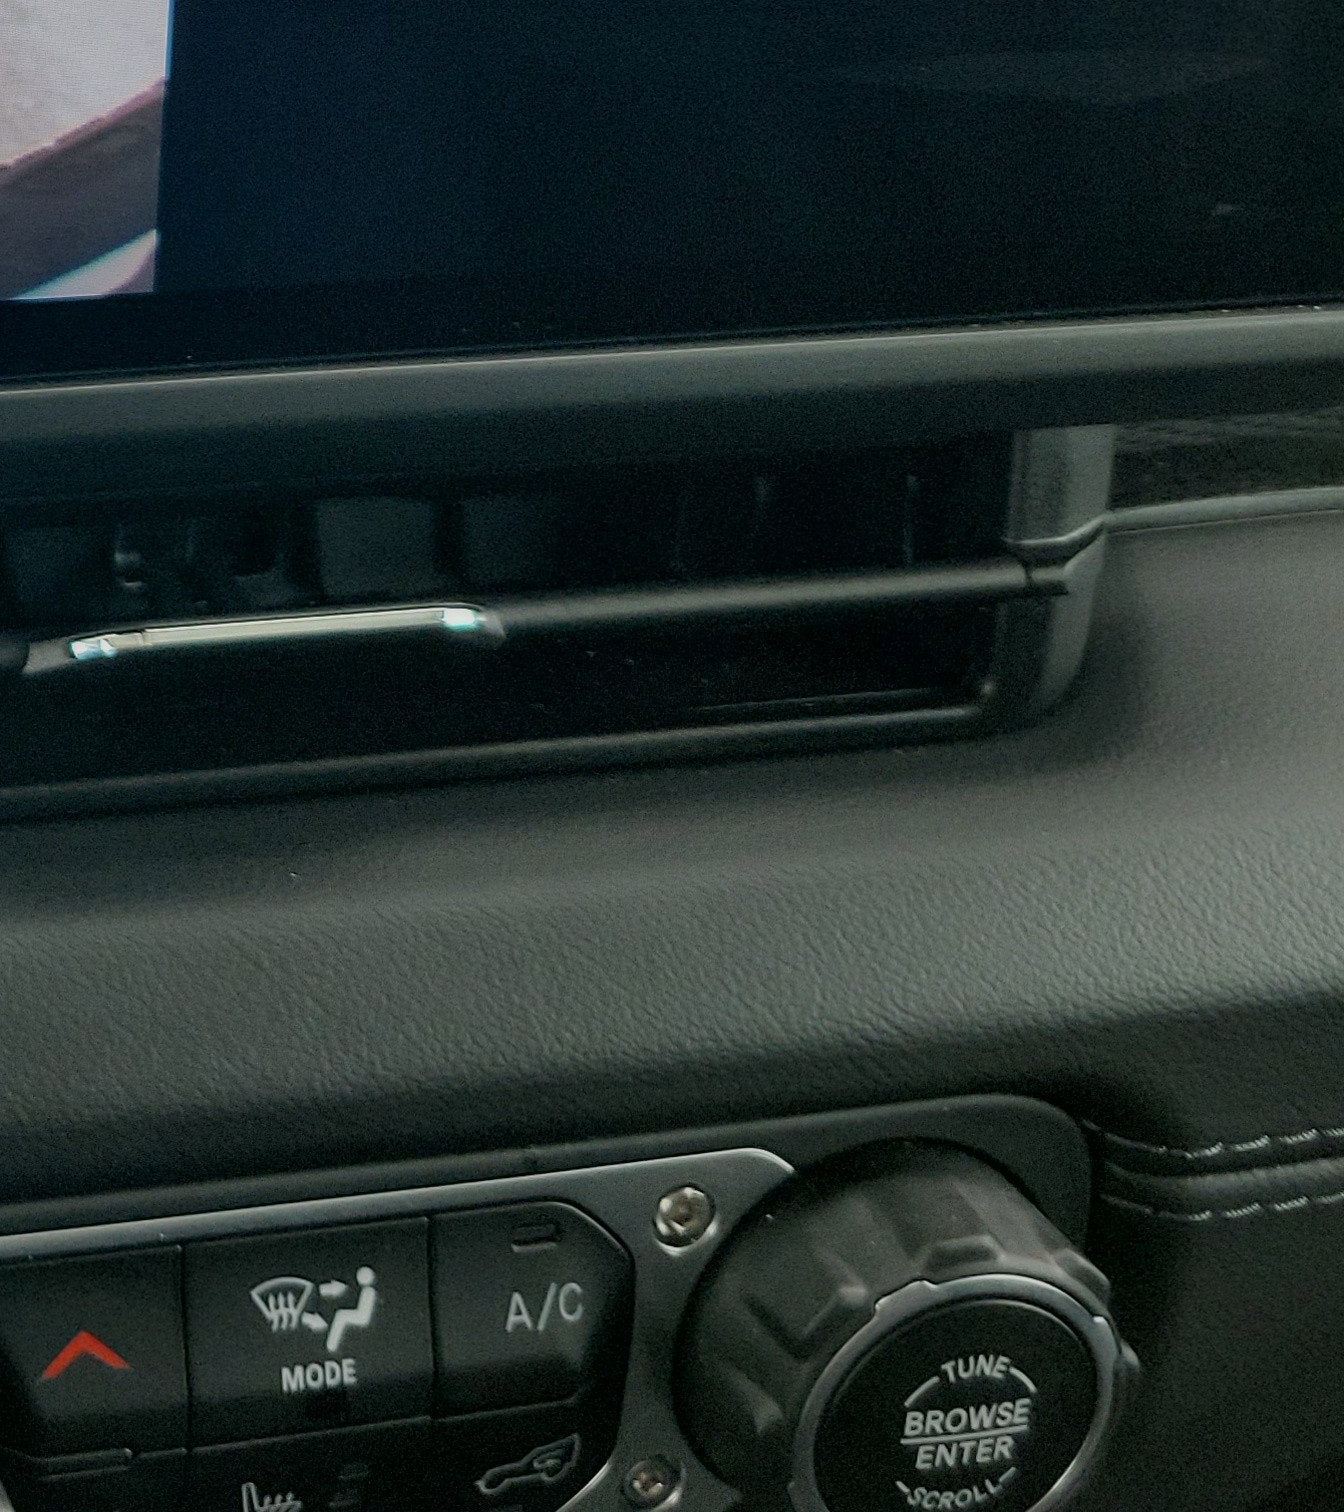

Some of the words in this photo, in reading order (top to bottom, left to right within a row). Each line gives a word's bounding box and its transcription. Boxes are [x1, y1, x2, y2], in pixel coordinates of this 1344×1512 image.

[505, 1282, 585, 1333] A/C
[281, 1358, 357, 1393] MODE
[941, 1354, 1011, 1385] TUNE
[904, 1397, 1032, 1437] BROWSE
[915, 1436, 1015, 1470] ENTER
[906, 1479, 1002, 1511] SCROLL
